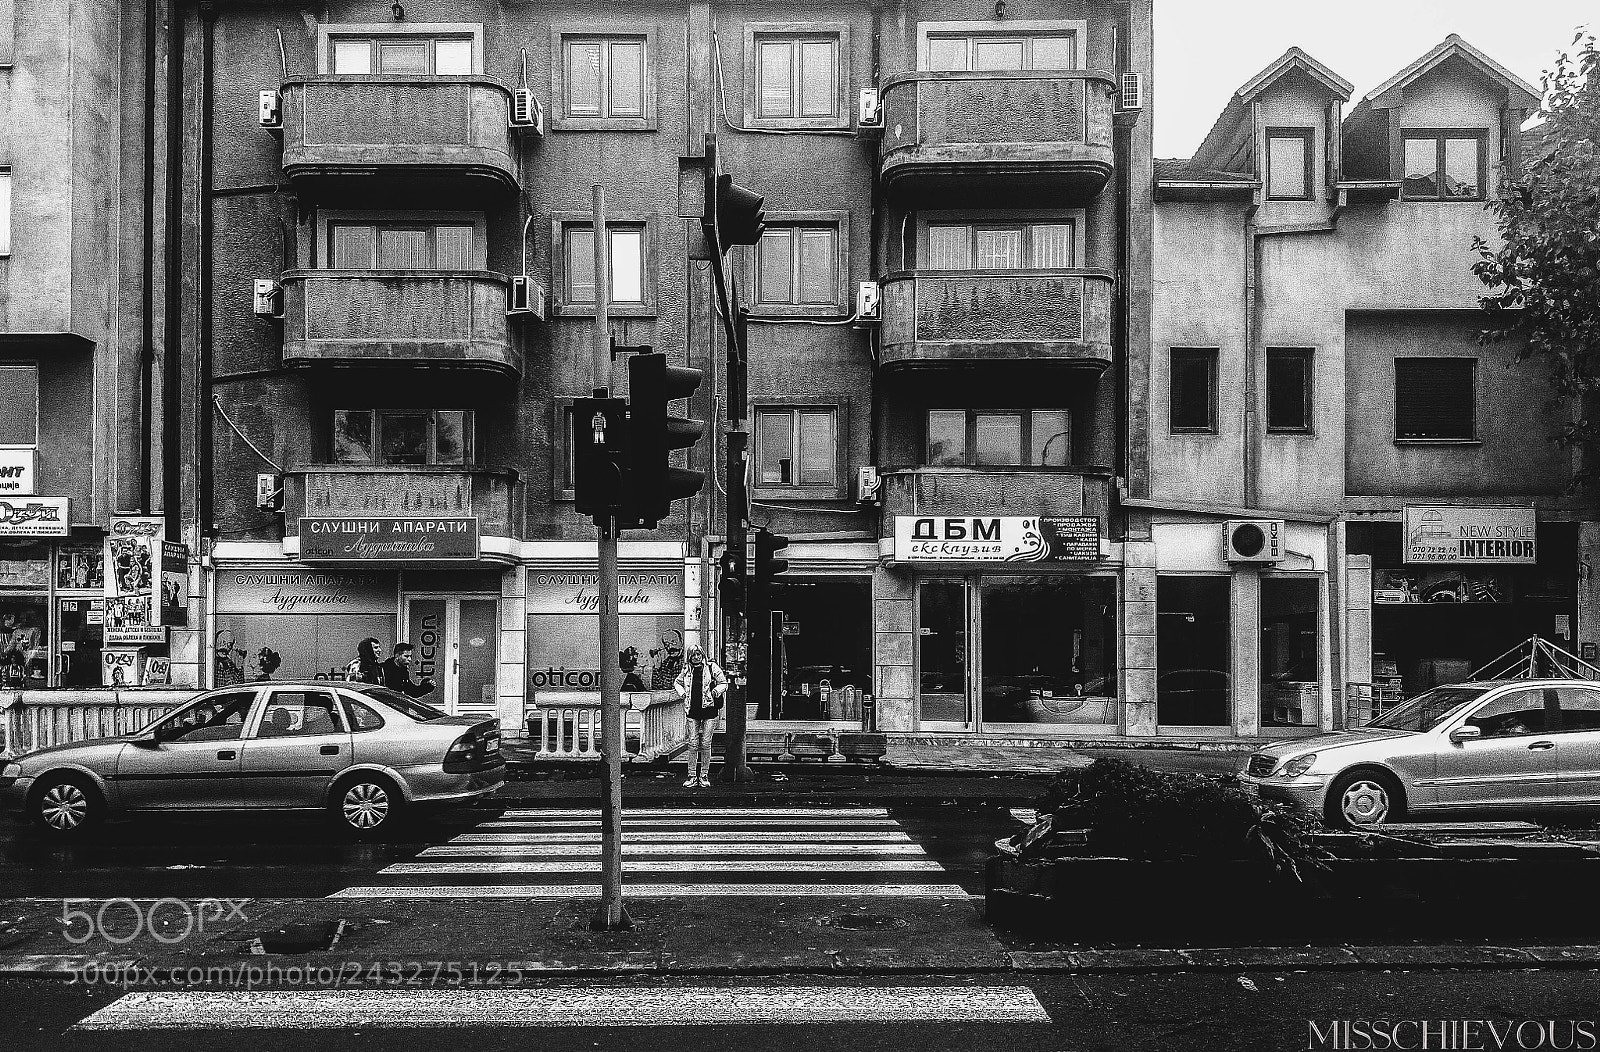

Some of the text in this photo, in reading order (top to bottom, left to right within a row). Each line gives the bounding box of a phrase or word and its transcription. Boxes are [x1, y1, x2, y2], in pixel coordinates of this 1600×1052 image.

[310, 521, 468, 534] СЛУШНИ АПАРАТИ
[911, 518, 1001, 540] ДБМ
[1460, 525, 1533, 538] NEW STYLE
[1460, 540, 1534, 558] INTERIOR
[235, 574, 378, 586] СЛУШНИ АПАРАТИ
[537, 574, 679, 585] СЛУШНИ ПАРАТИ
[415, 614, 438, 678] ticon
